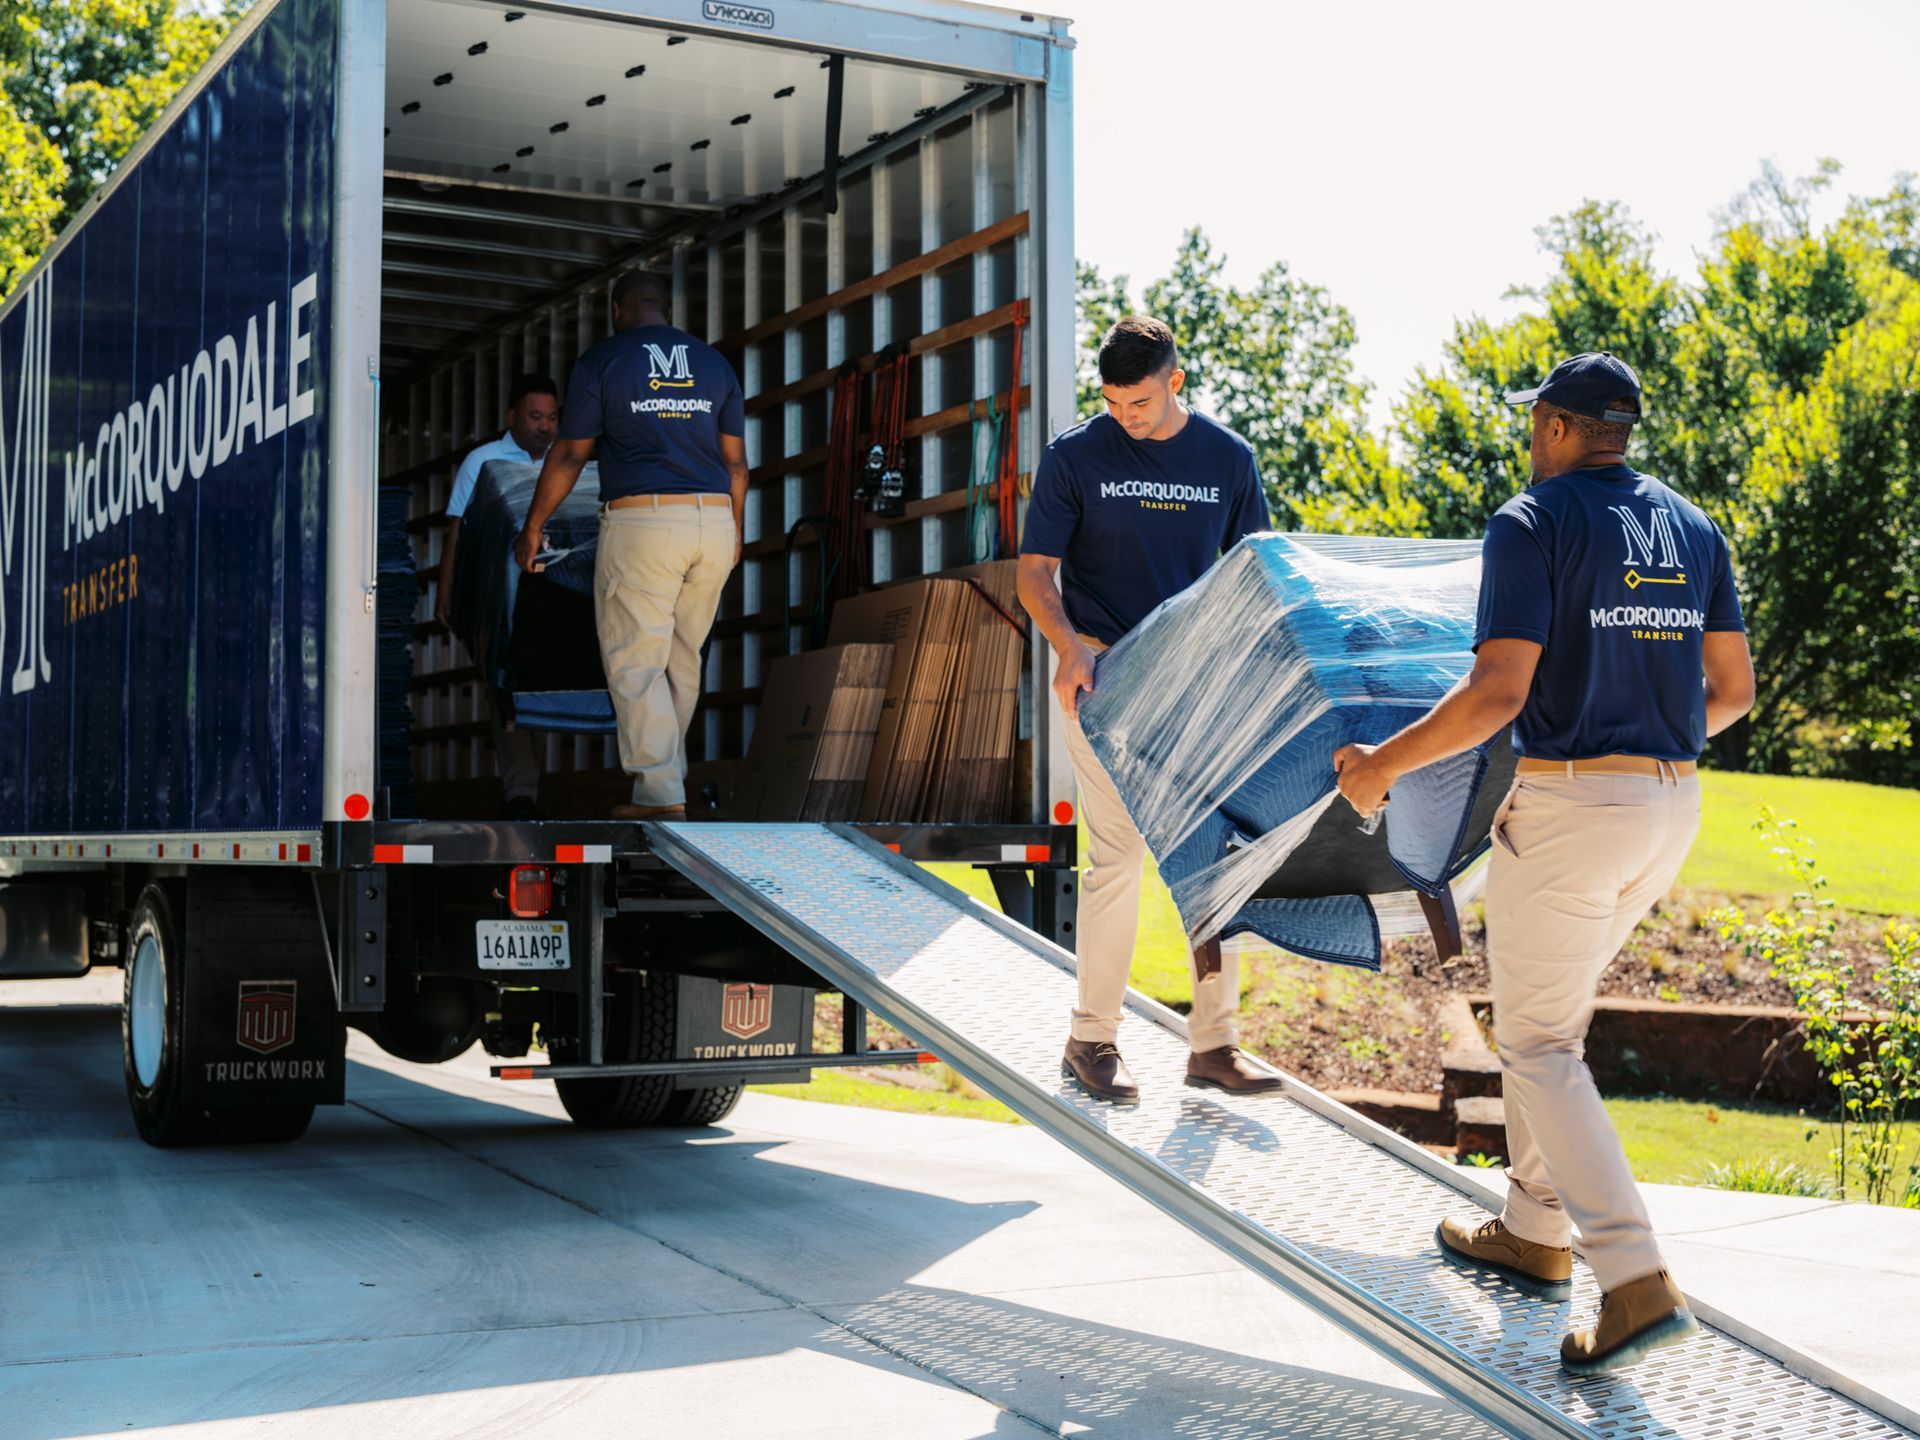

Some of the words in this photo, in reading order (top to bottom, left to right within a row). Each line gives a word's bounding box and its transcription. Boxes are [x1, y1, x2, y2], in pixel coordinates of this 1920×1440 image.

[706, 3, 770, 25] LYNCOACH
[642, 343, 694, 379] M
[64, 272, 318, 552] McCORQUODALE
[1100, 480, 1220, 503] McCORQUODALE
[1139, 499, 1187, 511] TRANSFER
[1607, 505, 1684, 568] M
[63, 553, 139, 626] TRANSFER
[1631, 630, 1684, 641] TRANSFER
[501, 924, 545, 933] ALABAMA
[483, 935, 563, 959] 16A1A9P
[204, 1060, 326, 1082] TRUCKWORX
